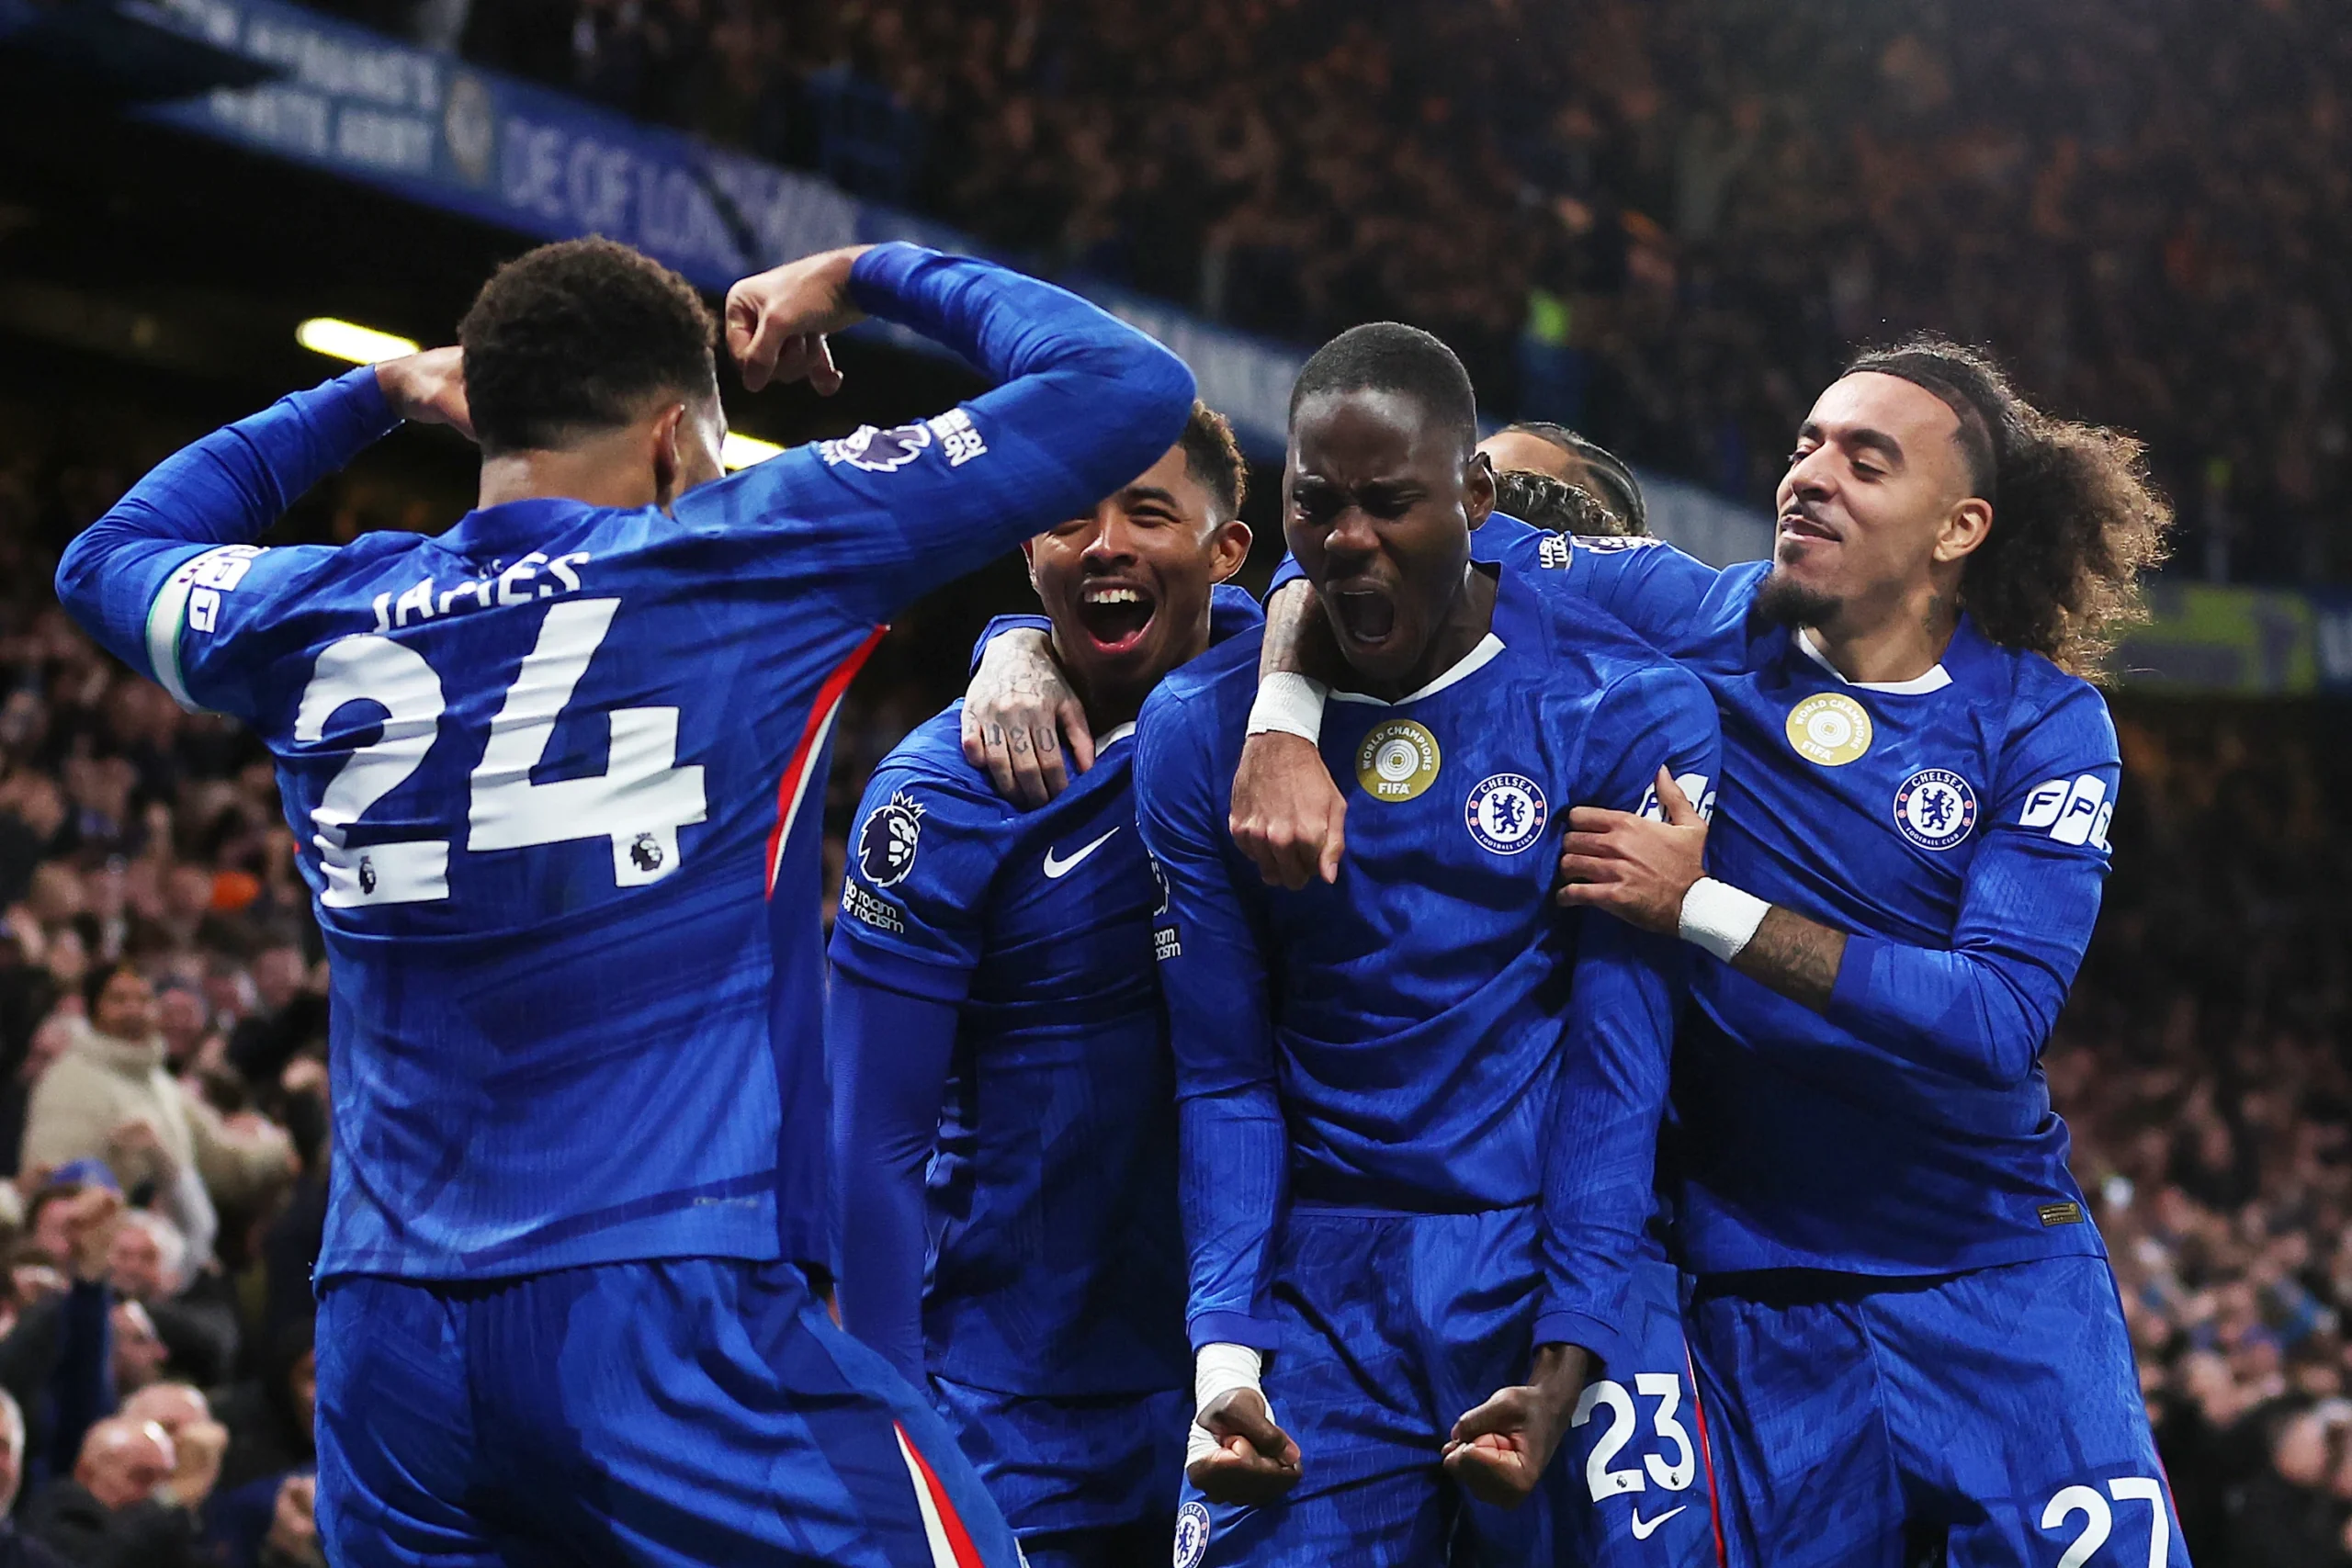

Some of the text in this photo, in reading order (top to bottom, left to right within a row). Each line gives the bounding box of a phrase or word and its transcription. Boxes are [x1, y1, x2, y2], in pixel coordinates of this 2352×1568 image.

[372, 551, 591, 634] JAMES
[1794, 699, 1864, 750] WORLD CHAMPIONS
[294, 597, 707, 908] 24
[1363, 726, 1432, 771] WORLD CHAMPIONS
[1801, 740, 1834, 761] FIFA
[1378, 783, 1410, 795] FIFA
[1480, 776, 1532, 794] CHELSEA
[1911, 772, 1963, 793] CHELSEA
[1479, 834, 1513, 850] FOOTBALL
[1905, 827, 1939, 846] FOOTBALL
[858, 890, 897, 918] room
[854, 904, 904, 934] racism
[1154, 928, 1175, 946] oom
[1571, 1373, 1695, 1503] 23
[2041, 1477, 2169, 1568] 27
